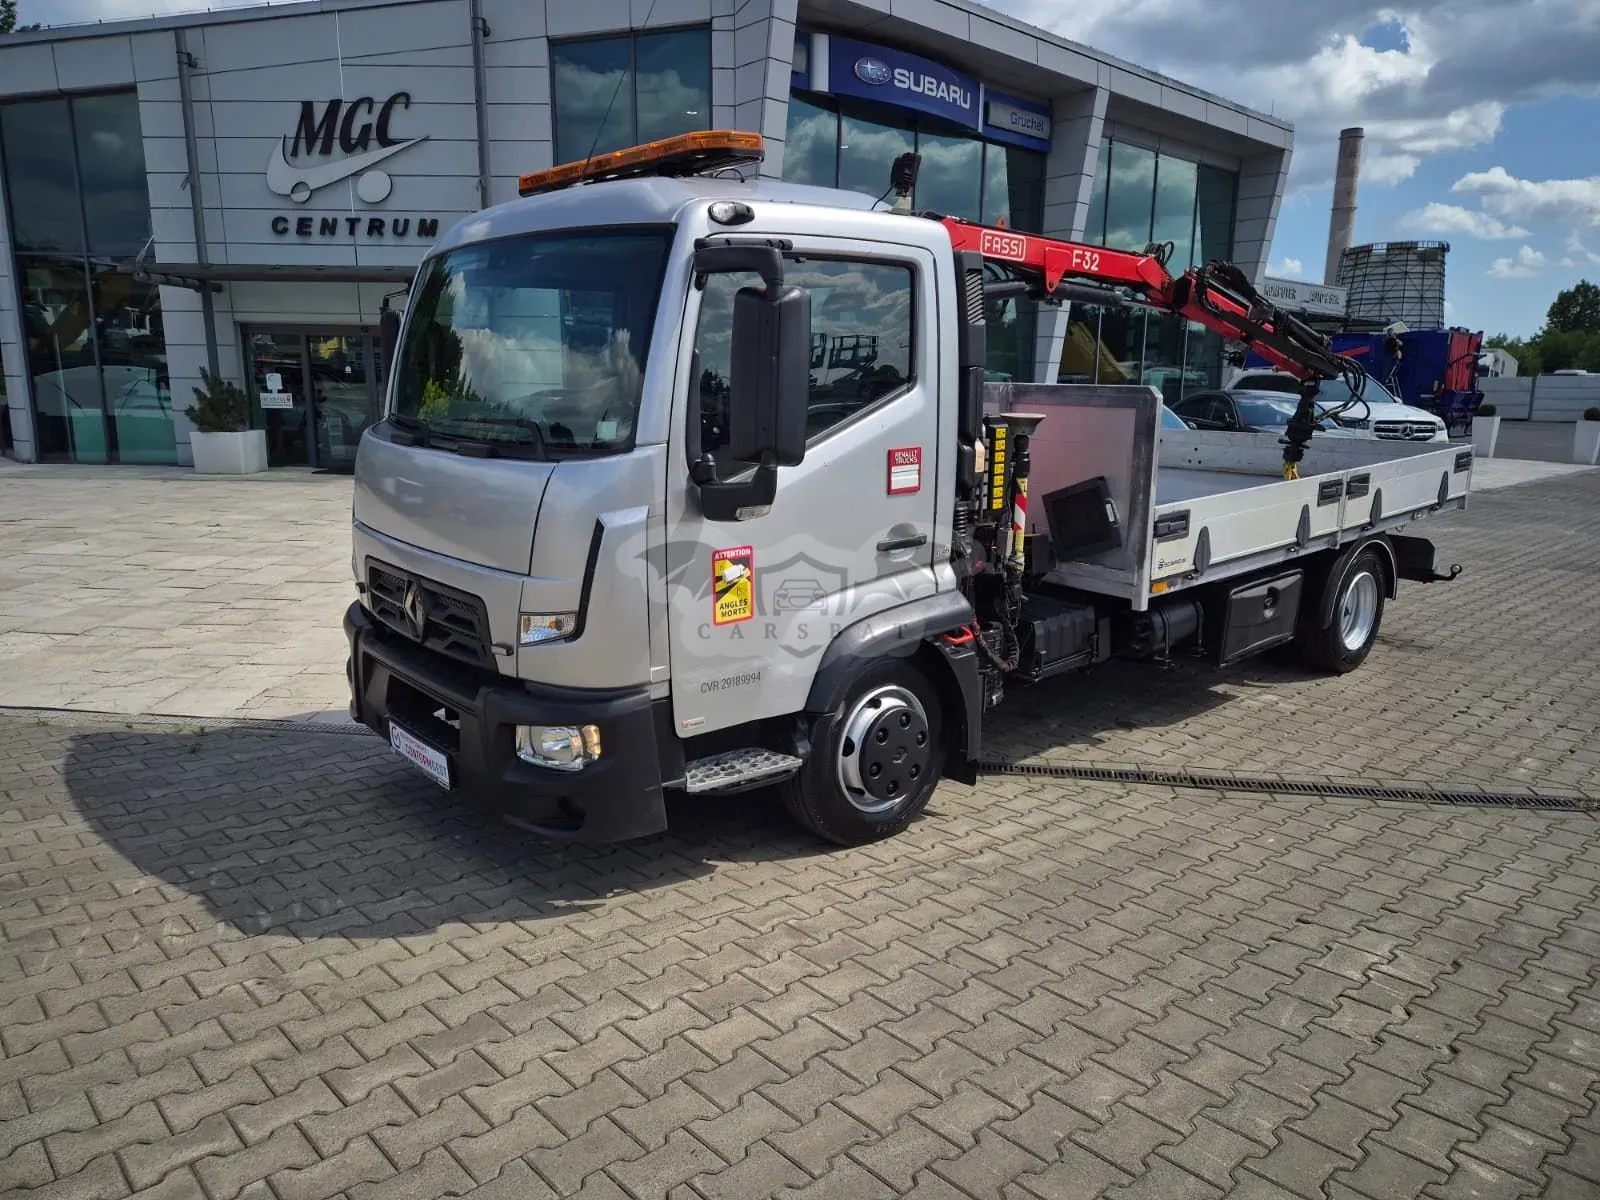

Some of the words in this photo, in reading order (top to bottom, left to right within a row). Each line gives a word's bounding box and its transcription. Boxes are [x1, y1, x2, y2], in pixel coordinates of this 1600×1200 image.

[893, 68, 971, 110] SUBARU
[290, 91, 411, 157] MGC
[1010, 111, 1044, 131] Gruchel
[271, 216, 439, 237] CENTRUM
[983, 235, 1023, 256] FASSI
[1072, 249, 1099, 271] F32
[895, 456, 918, 464] TRUCKS
[714, 548, 751, 560] ATTENTION
[719, 598, 748, 610] ANGLES
[720, 606, 747, 618] MORTS
[700, 680, 719, 694] CVR
[721, 671, 761, 690] 29189994
